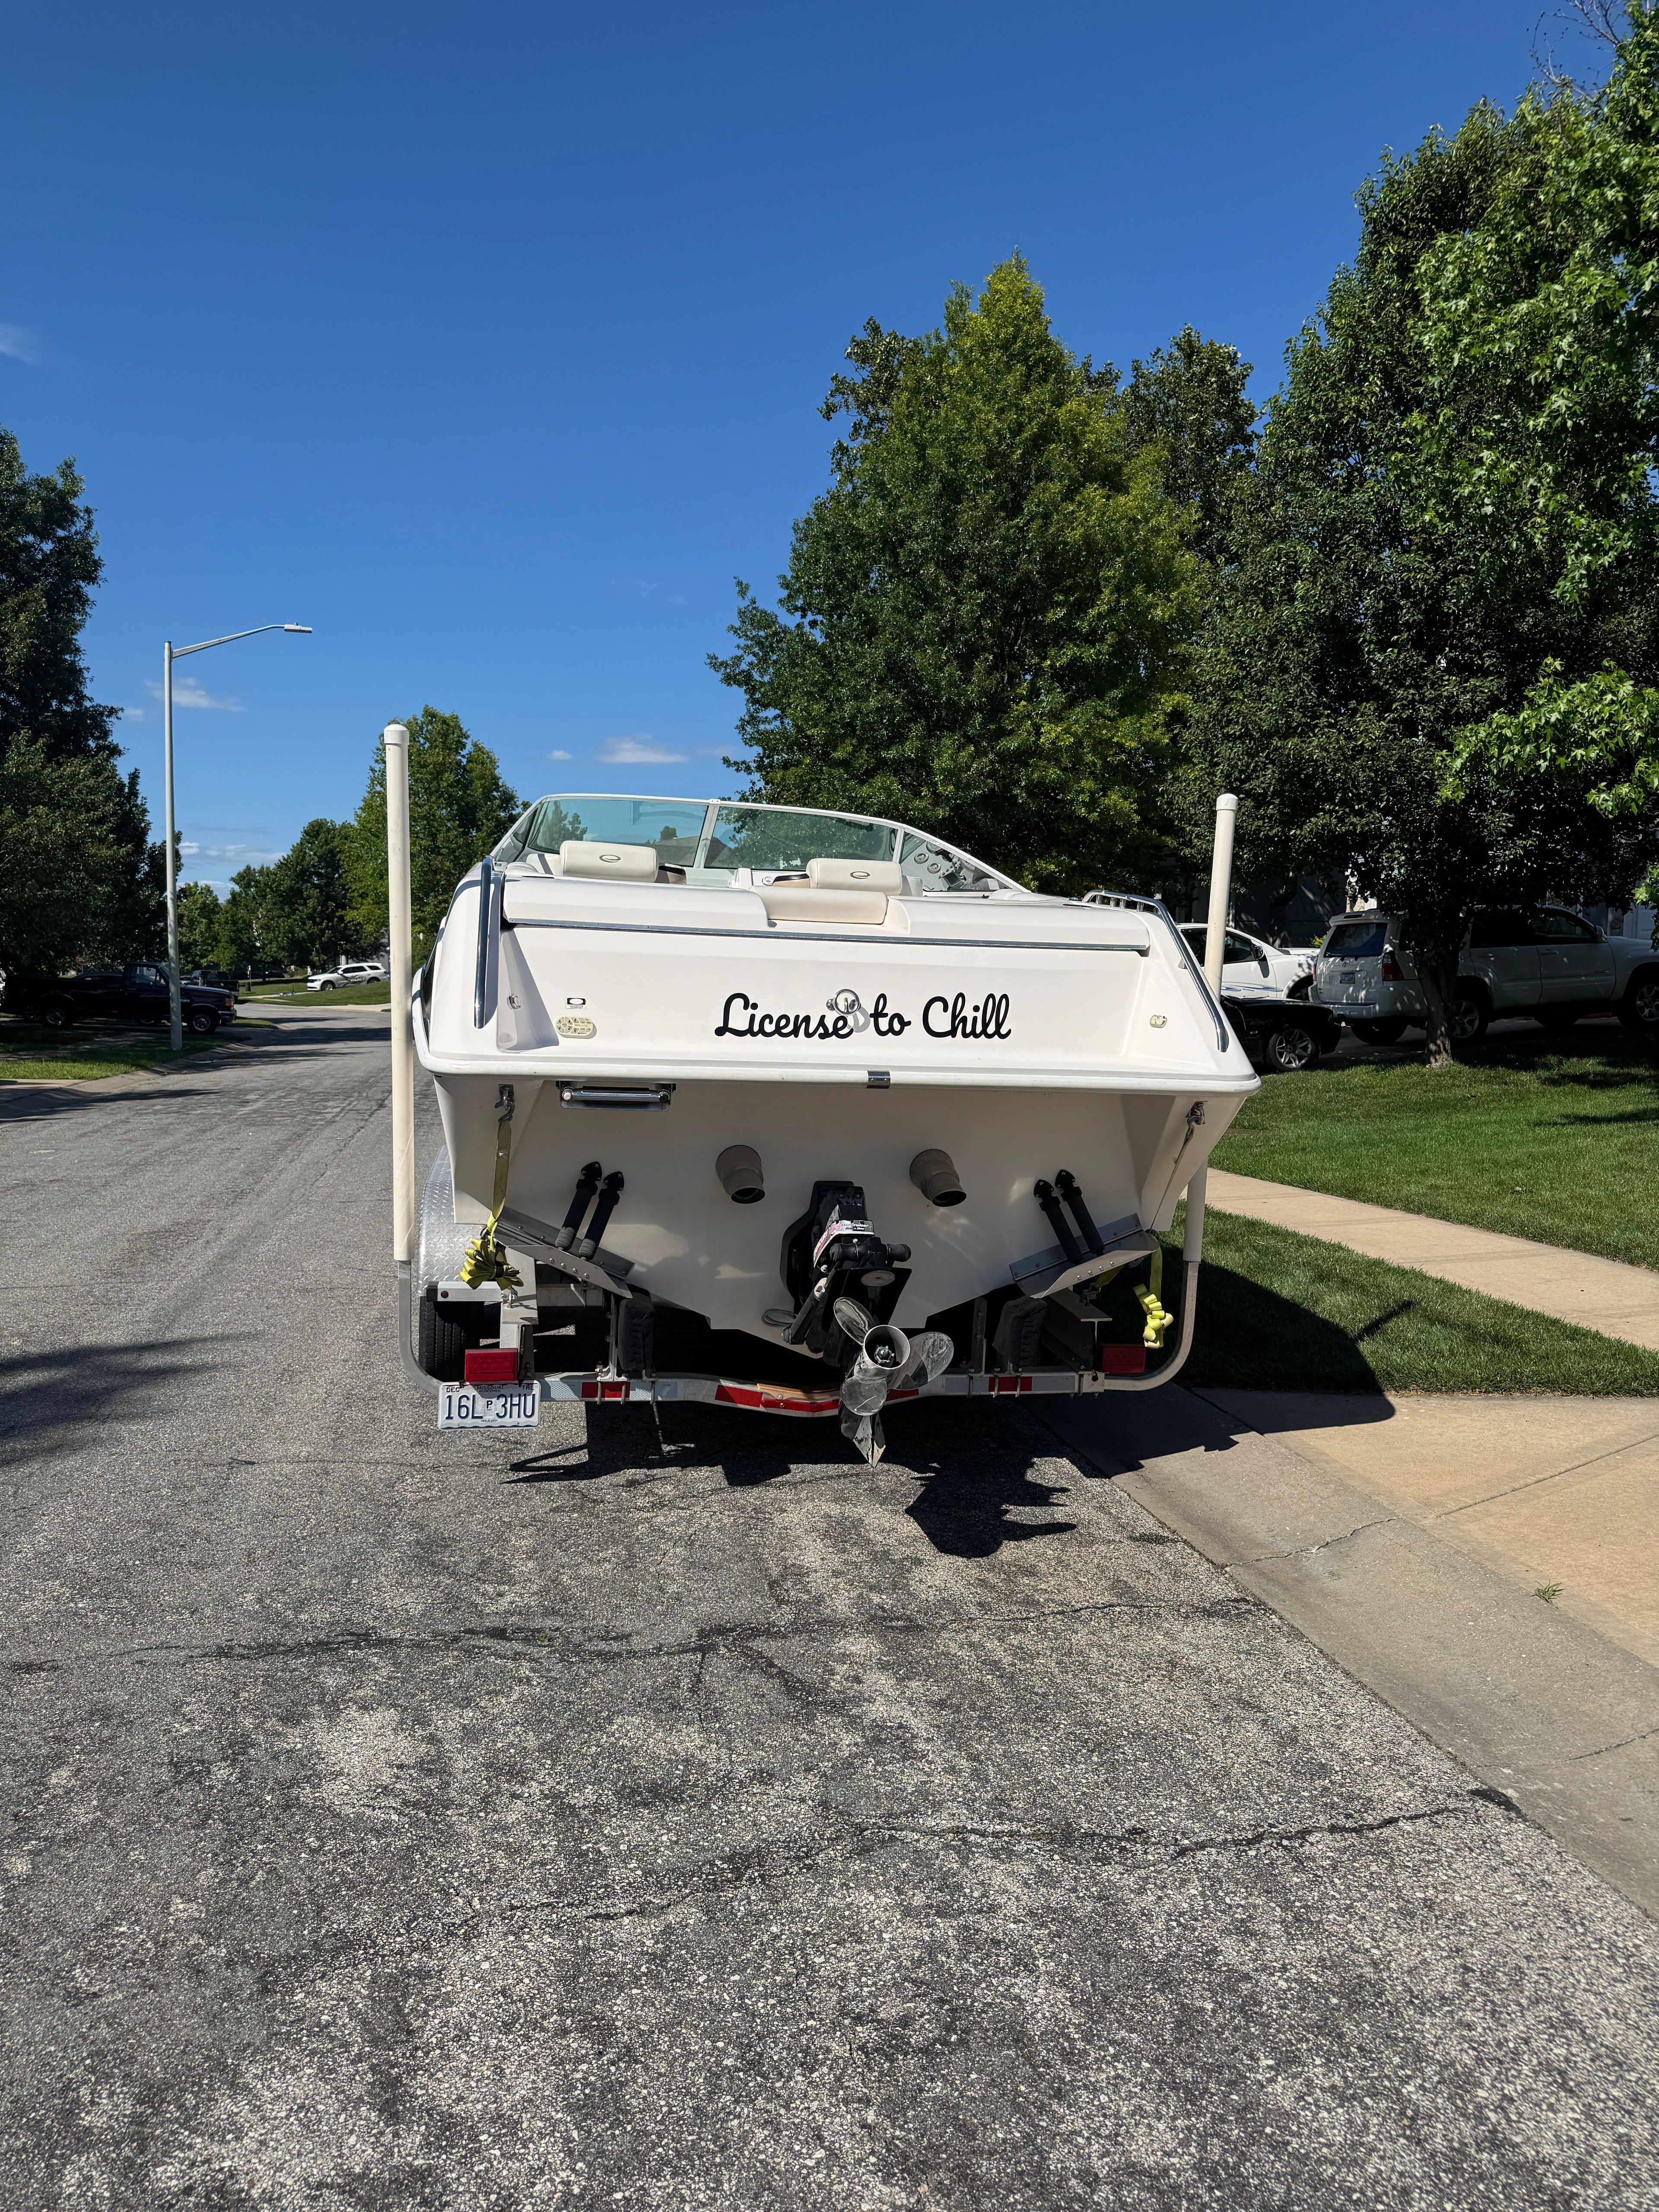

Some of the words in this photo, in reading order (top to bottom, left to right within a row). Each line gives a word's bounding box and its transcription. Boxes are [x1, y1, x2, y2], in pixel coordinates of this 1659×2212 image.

[715, 993, 854, 1040] License
[869, 993, 912, 1036] to
[922, 992, 1012, 1039] Chill
[445, 1394, 483, 1420] 16L
[486, 1400, 493, 1408] P
[496, 1393, 535, 1418] 3HU
